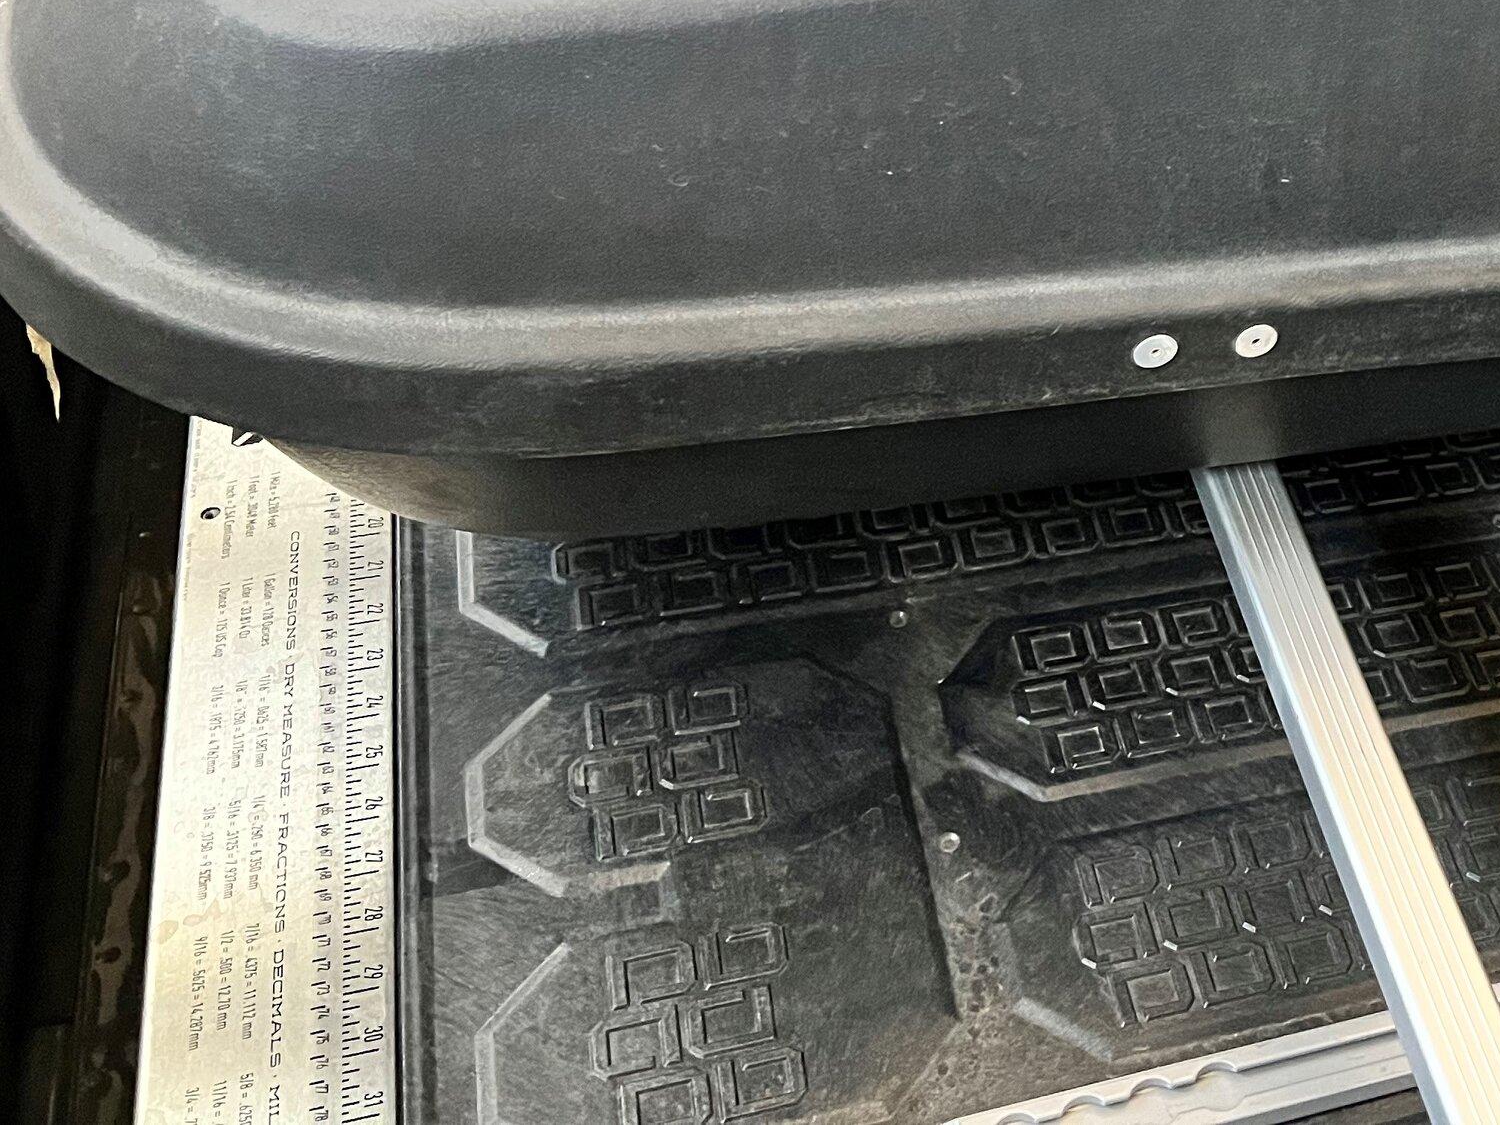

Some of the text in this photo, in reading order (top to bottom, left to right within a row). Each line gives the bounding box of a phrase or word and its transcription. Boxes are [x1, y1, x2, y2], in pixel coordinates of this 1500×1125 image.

[286, 531, 300, 650] CONVERSIONS
[284, 663, 295, 697] DRY
[280, 705, 293, 798] MEASURE
[322, 766, 334, 774] 63
[322, 786, 334, 794] 64
[321, 807, 333, 815] 65
[364, 517, 384, 1107] 20 21 22 23 24 25 26 27 28 29 30 31
[321, 828, 333, 836] 66
[274, 813, 289, 933] FRACTIONS
[320, 871, 332, 879] 68
[320, 893, 332, 901] 69
[220, 931, 235, 945] 1/2
[245, 923, 260, 944] 7/16
[193, 937, 208, 957] 9/16
[318, 938, 331, 947] 71
[317, 961, 330, 972] 72
[317, 985, 330, 995] 73
[242, 990, 256, 1021] 11.112
[270, 950, 284, 1067] DECIMALS
[318, 1008, 330, 1019] 74
[217, 1013, 226, 1030] mm
[242, 1023, 252, 1040] mm
[317, 1033, 330, 1044] 75
[316, 1058, 329, 1069] 76
[240, 1073, 253, 1089] 5/8
[185, 1087, 200, 1104] 3/4
[212, 1081, 227, 1108] 11/16
[316, 1084, 328, 1093] 77
[315, 1110, 328, 1121] 78
